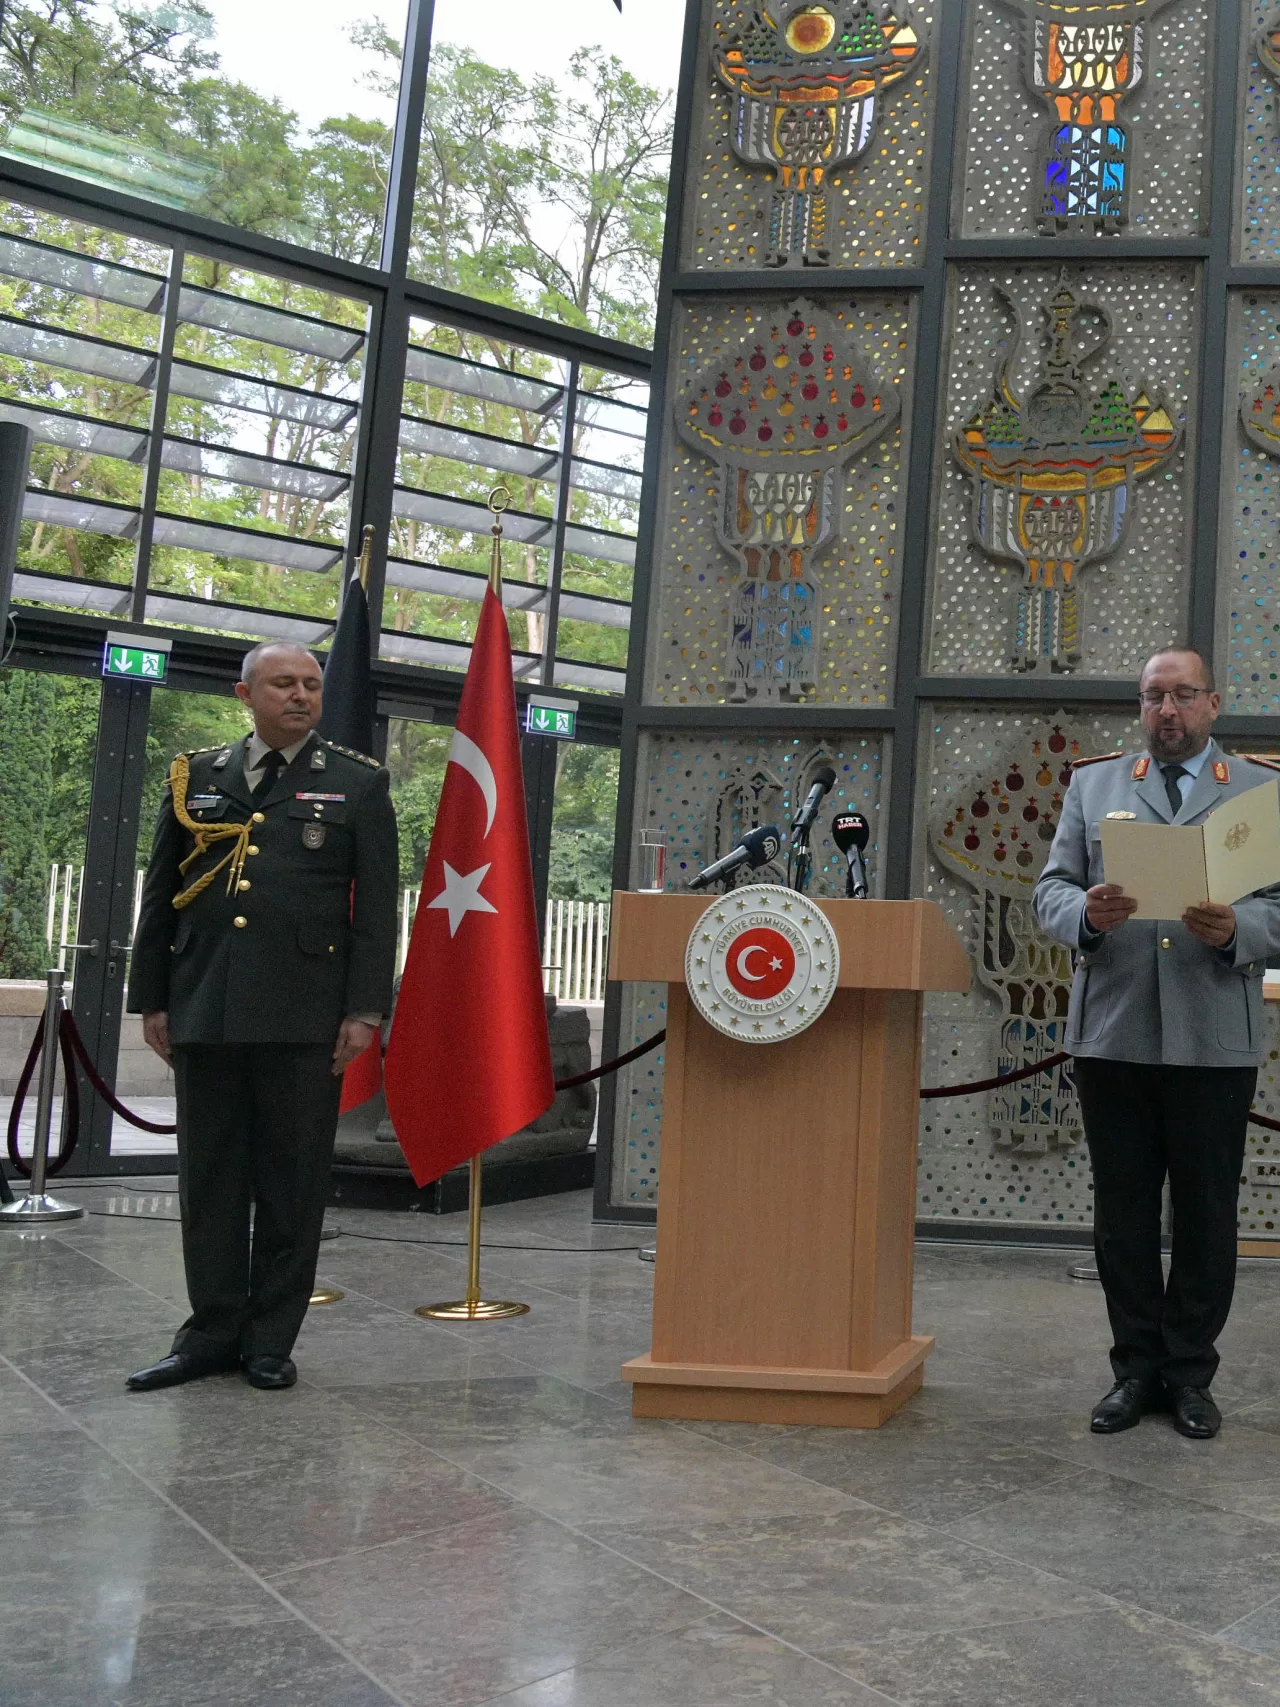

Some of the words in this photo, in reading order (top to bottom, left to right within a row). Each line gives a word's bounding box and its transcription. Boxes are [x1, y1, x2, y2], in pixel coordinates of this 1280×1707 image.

[837, 816, 861, 824] TRT
[837, 822, 863, 830] HABER
[716, 919, 748, 954] TÜRKİYE
[749, 916, 808, 957] CUMHURİYETİ
